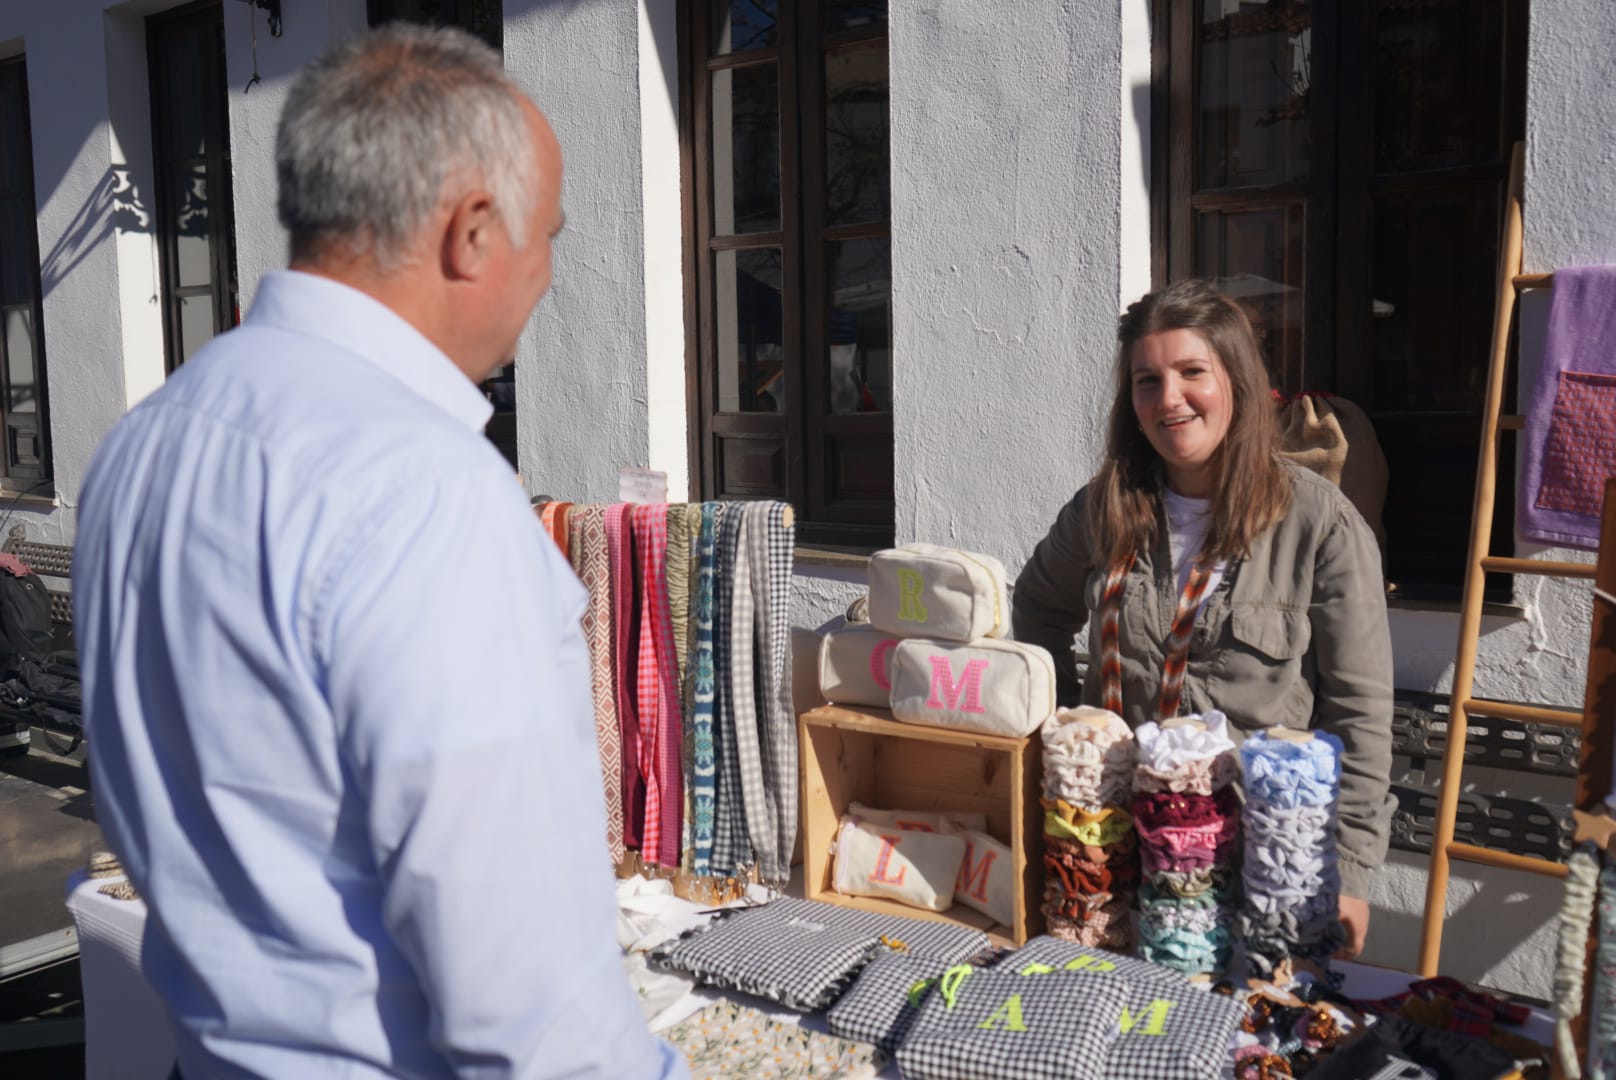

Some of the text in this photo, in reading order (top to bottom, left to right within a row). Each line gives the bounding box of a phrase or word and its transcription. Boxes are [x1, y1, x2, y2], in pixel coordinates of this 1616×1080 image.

[897, 568, 928, 623] R
[926, 655, 989, 714] M
[868, 834, 907, 887] L
[955, 840, 997, 904] M
[976, 993, 1028, 1032] A
